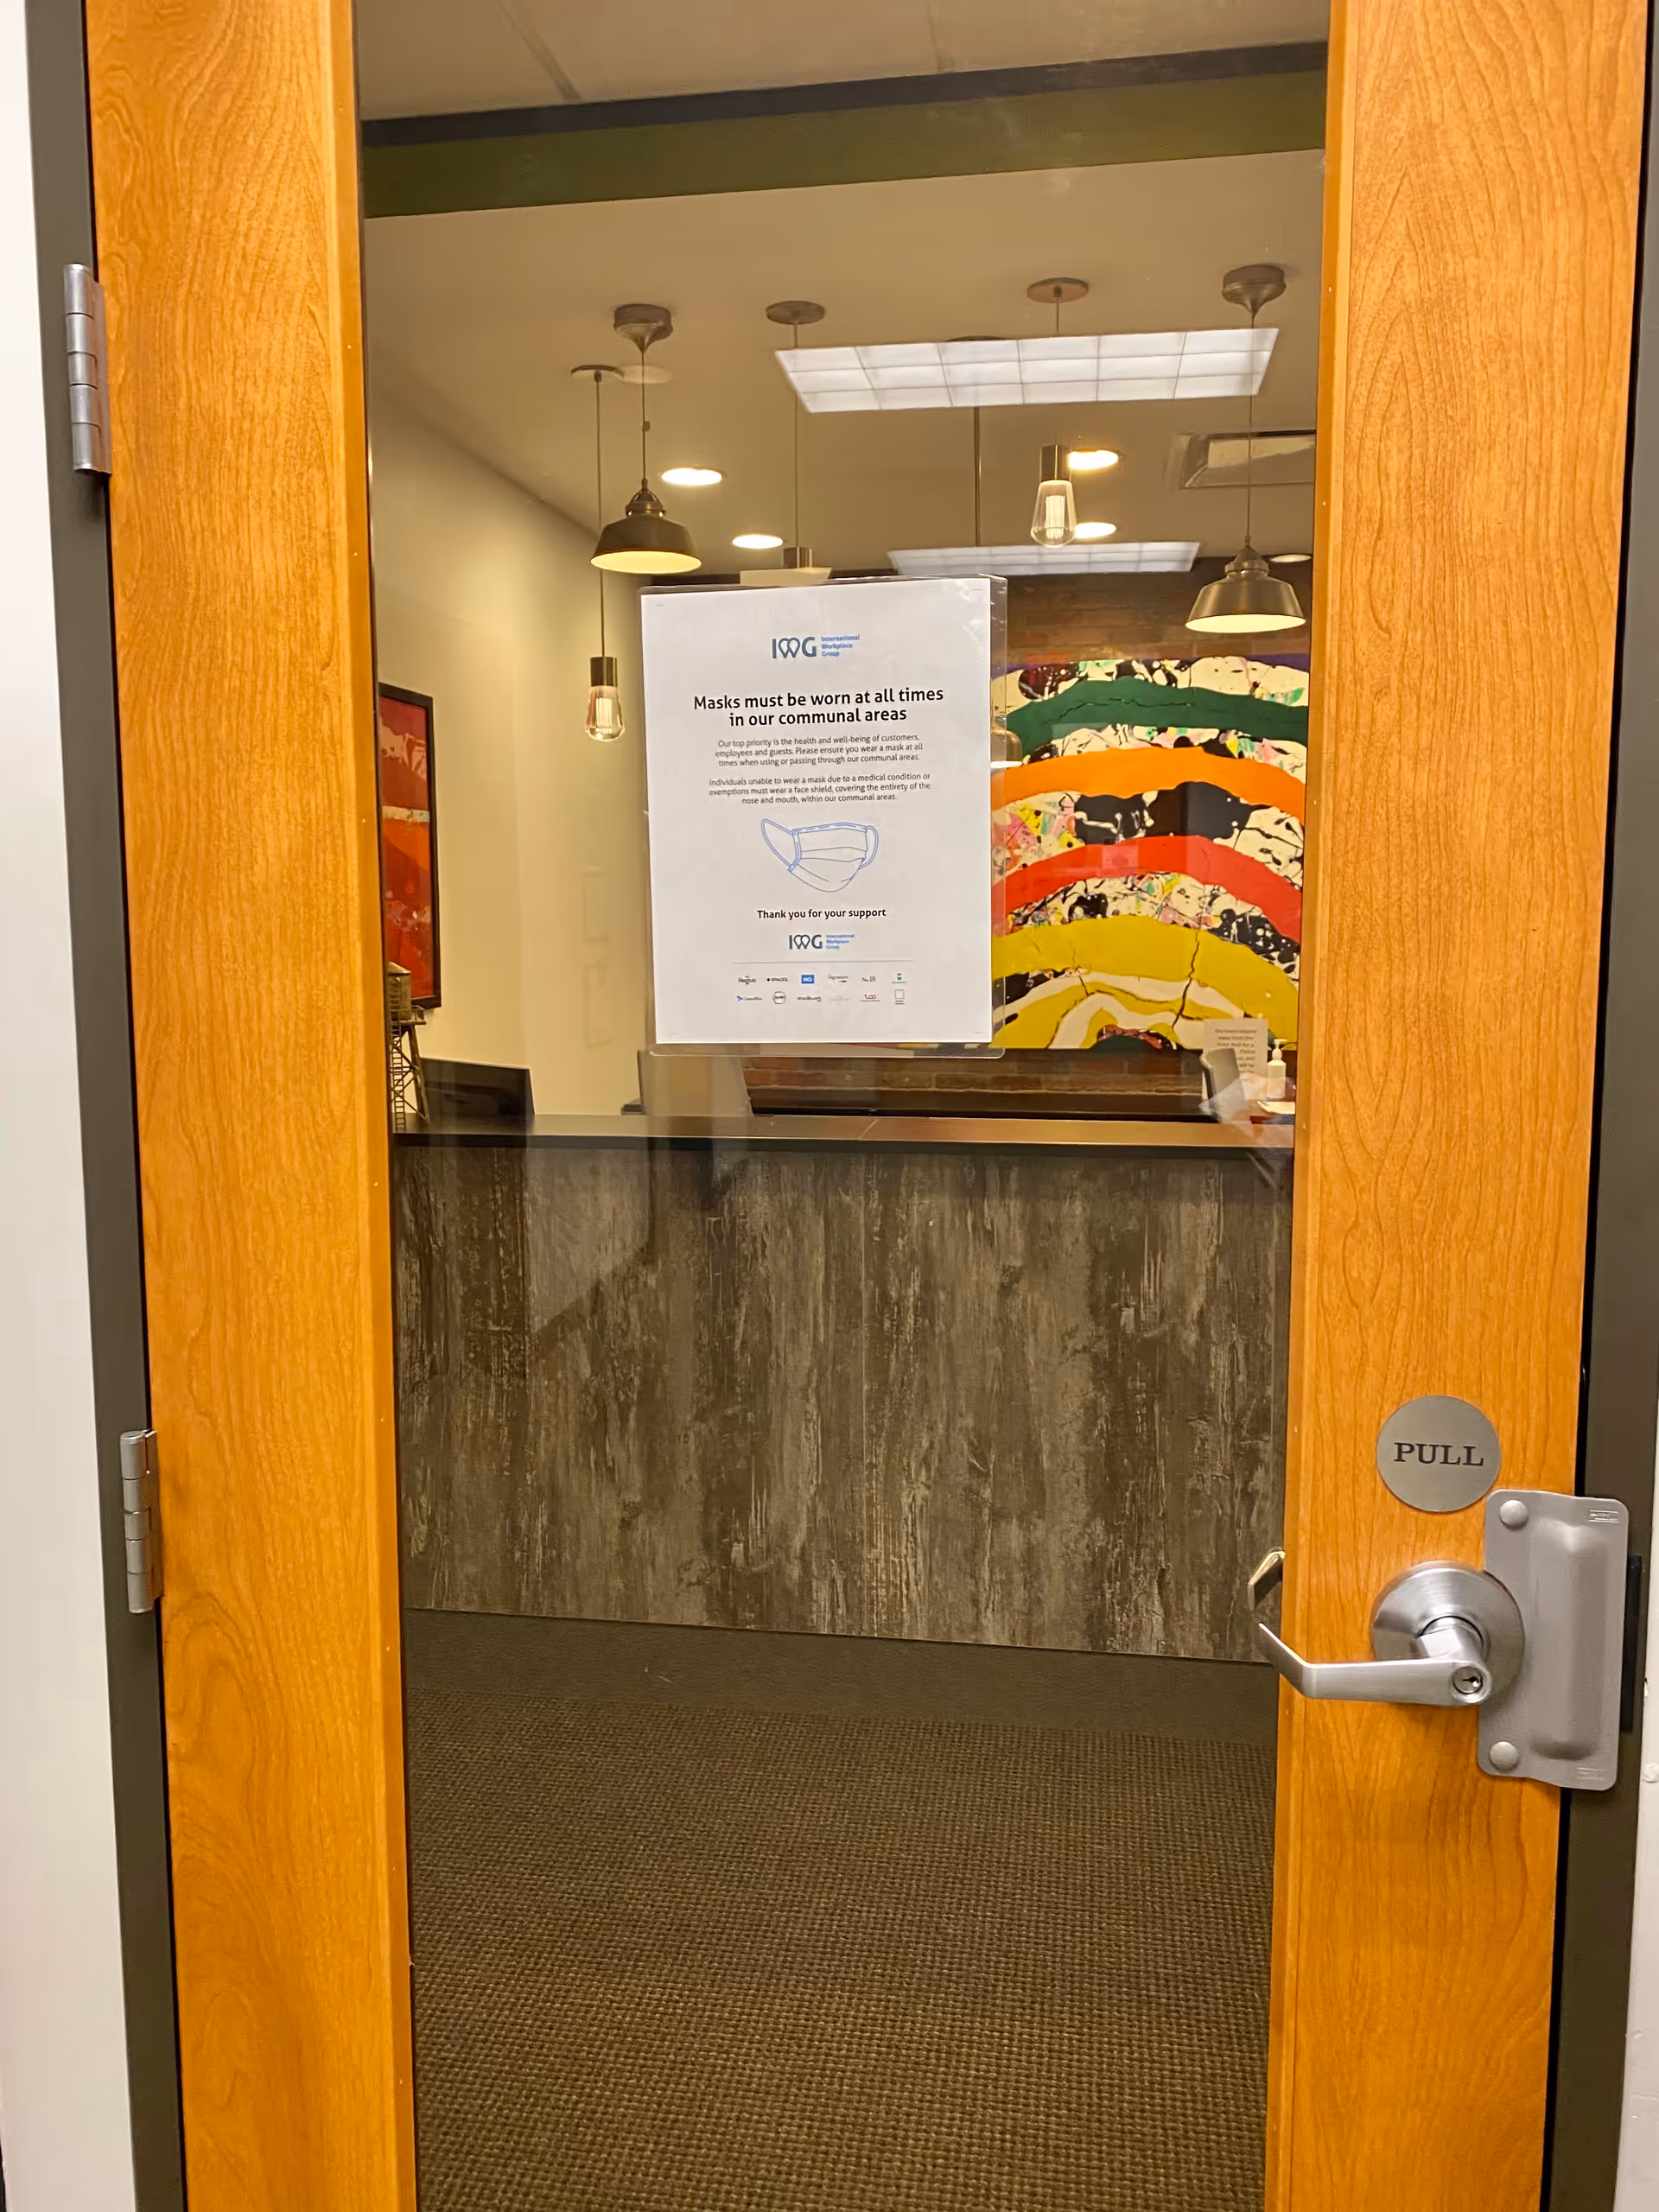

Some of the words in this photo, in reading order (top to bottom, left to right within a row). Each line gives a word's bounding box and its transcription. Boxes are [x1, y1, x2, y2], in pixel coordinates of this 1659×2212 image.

[772, 637, 817, 658] IWG
[694, 695, 740, 710] Masks
[745, 694, 784, 708] must
[788, 692, 807, 707] be
[810, 694, 850, 706] worn
[855, 691, 871, 704] at
[875, 689, 895, 703] all
[898, 688, 944, 702] times
[729, 712, 744, 727] in
[749, 715, 775, 726] our
[779, 708, 861, 725] communal
[865, 709, 907, 722] areas
[732, 741, 745, 749] top
[746, 739, 772, 748] priority
[818, 736, 832, 744] and
[833, 735, 871, 744] well-being
[872, 734, 880, 742] of
[715, 749, 753, 757] employees
[845, 747, 859, 755] you
[885, 743, 904, 751] mask
[719, 758, 738, 766] times
[760, 758, 780, 767] using
[790, 757, 817, 767] passing
[817, 755, 846, 765] through
[860, 753, 898, 762] communal
[709, 778, 747, 786] Individuals
[709, 788, 749, 797] exemptions
[835, 784, 866, 793] covering
[880, 783, 908, 792] entirety
[838, 793, 875, 802] communal
[757, 910, 786, 919] Thank
[788, 911, 806, 921] you
[808, 909, 823, 918] for
[824, 910, 847, 920] your
[849, 909, 887, 919] support
[789, 934, 822, 949] IWG
[1394, 1442, 1484, 1466] PULL
